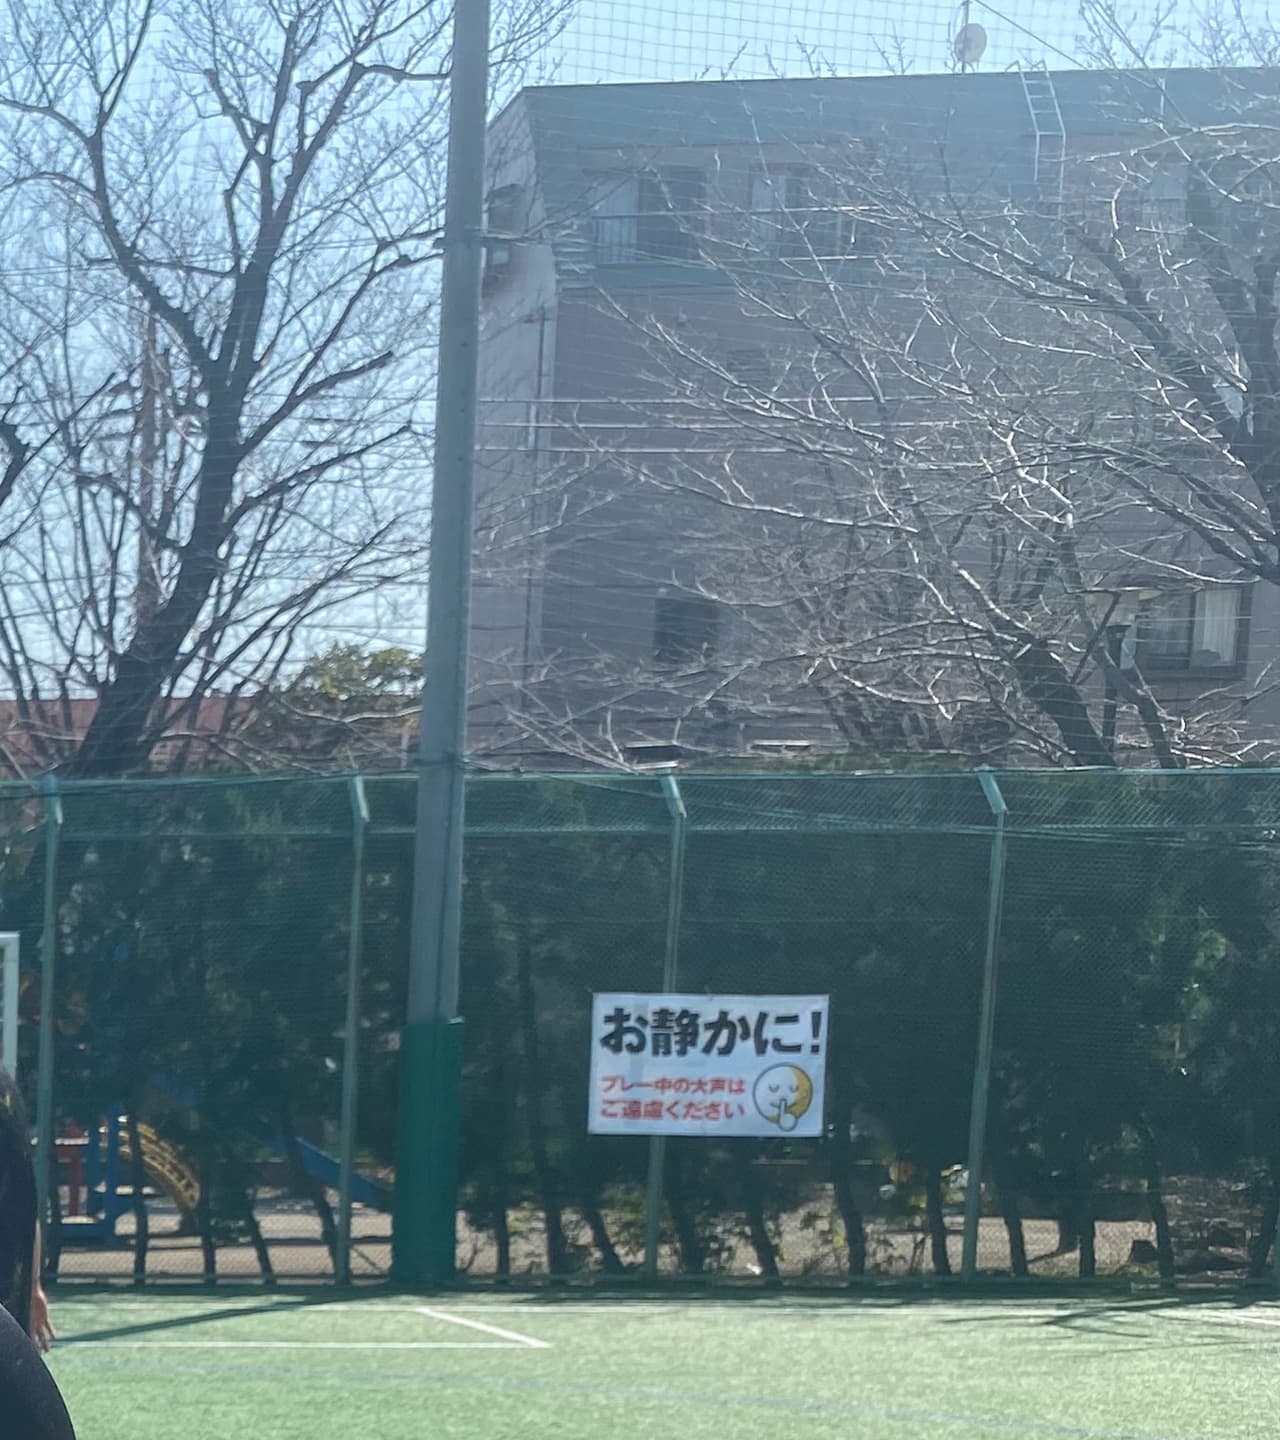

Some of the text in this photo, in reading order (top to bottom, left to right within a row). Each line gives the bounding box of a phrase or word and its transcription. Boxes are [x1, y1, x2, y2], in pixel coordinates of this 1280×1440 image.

[599, 1007, 824, 1057] お静かに!
[600, 1075, 746, 1095] プレー中の大声は
[600, 1100, 746, 1120] ご遠慮ください
